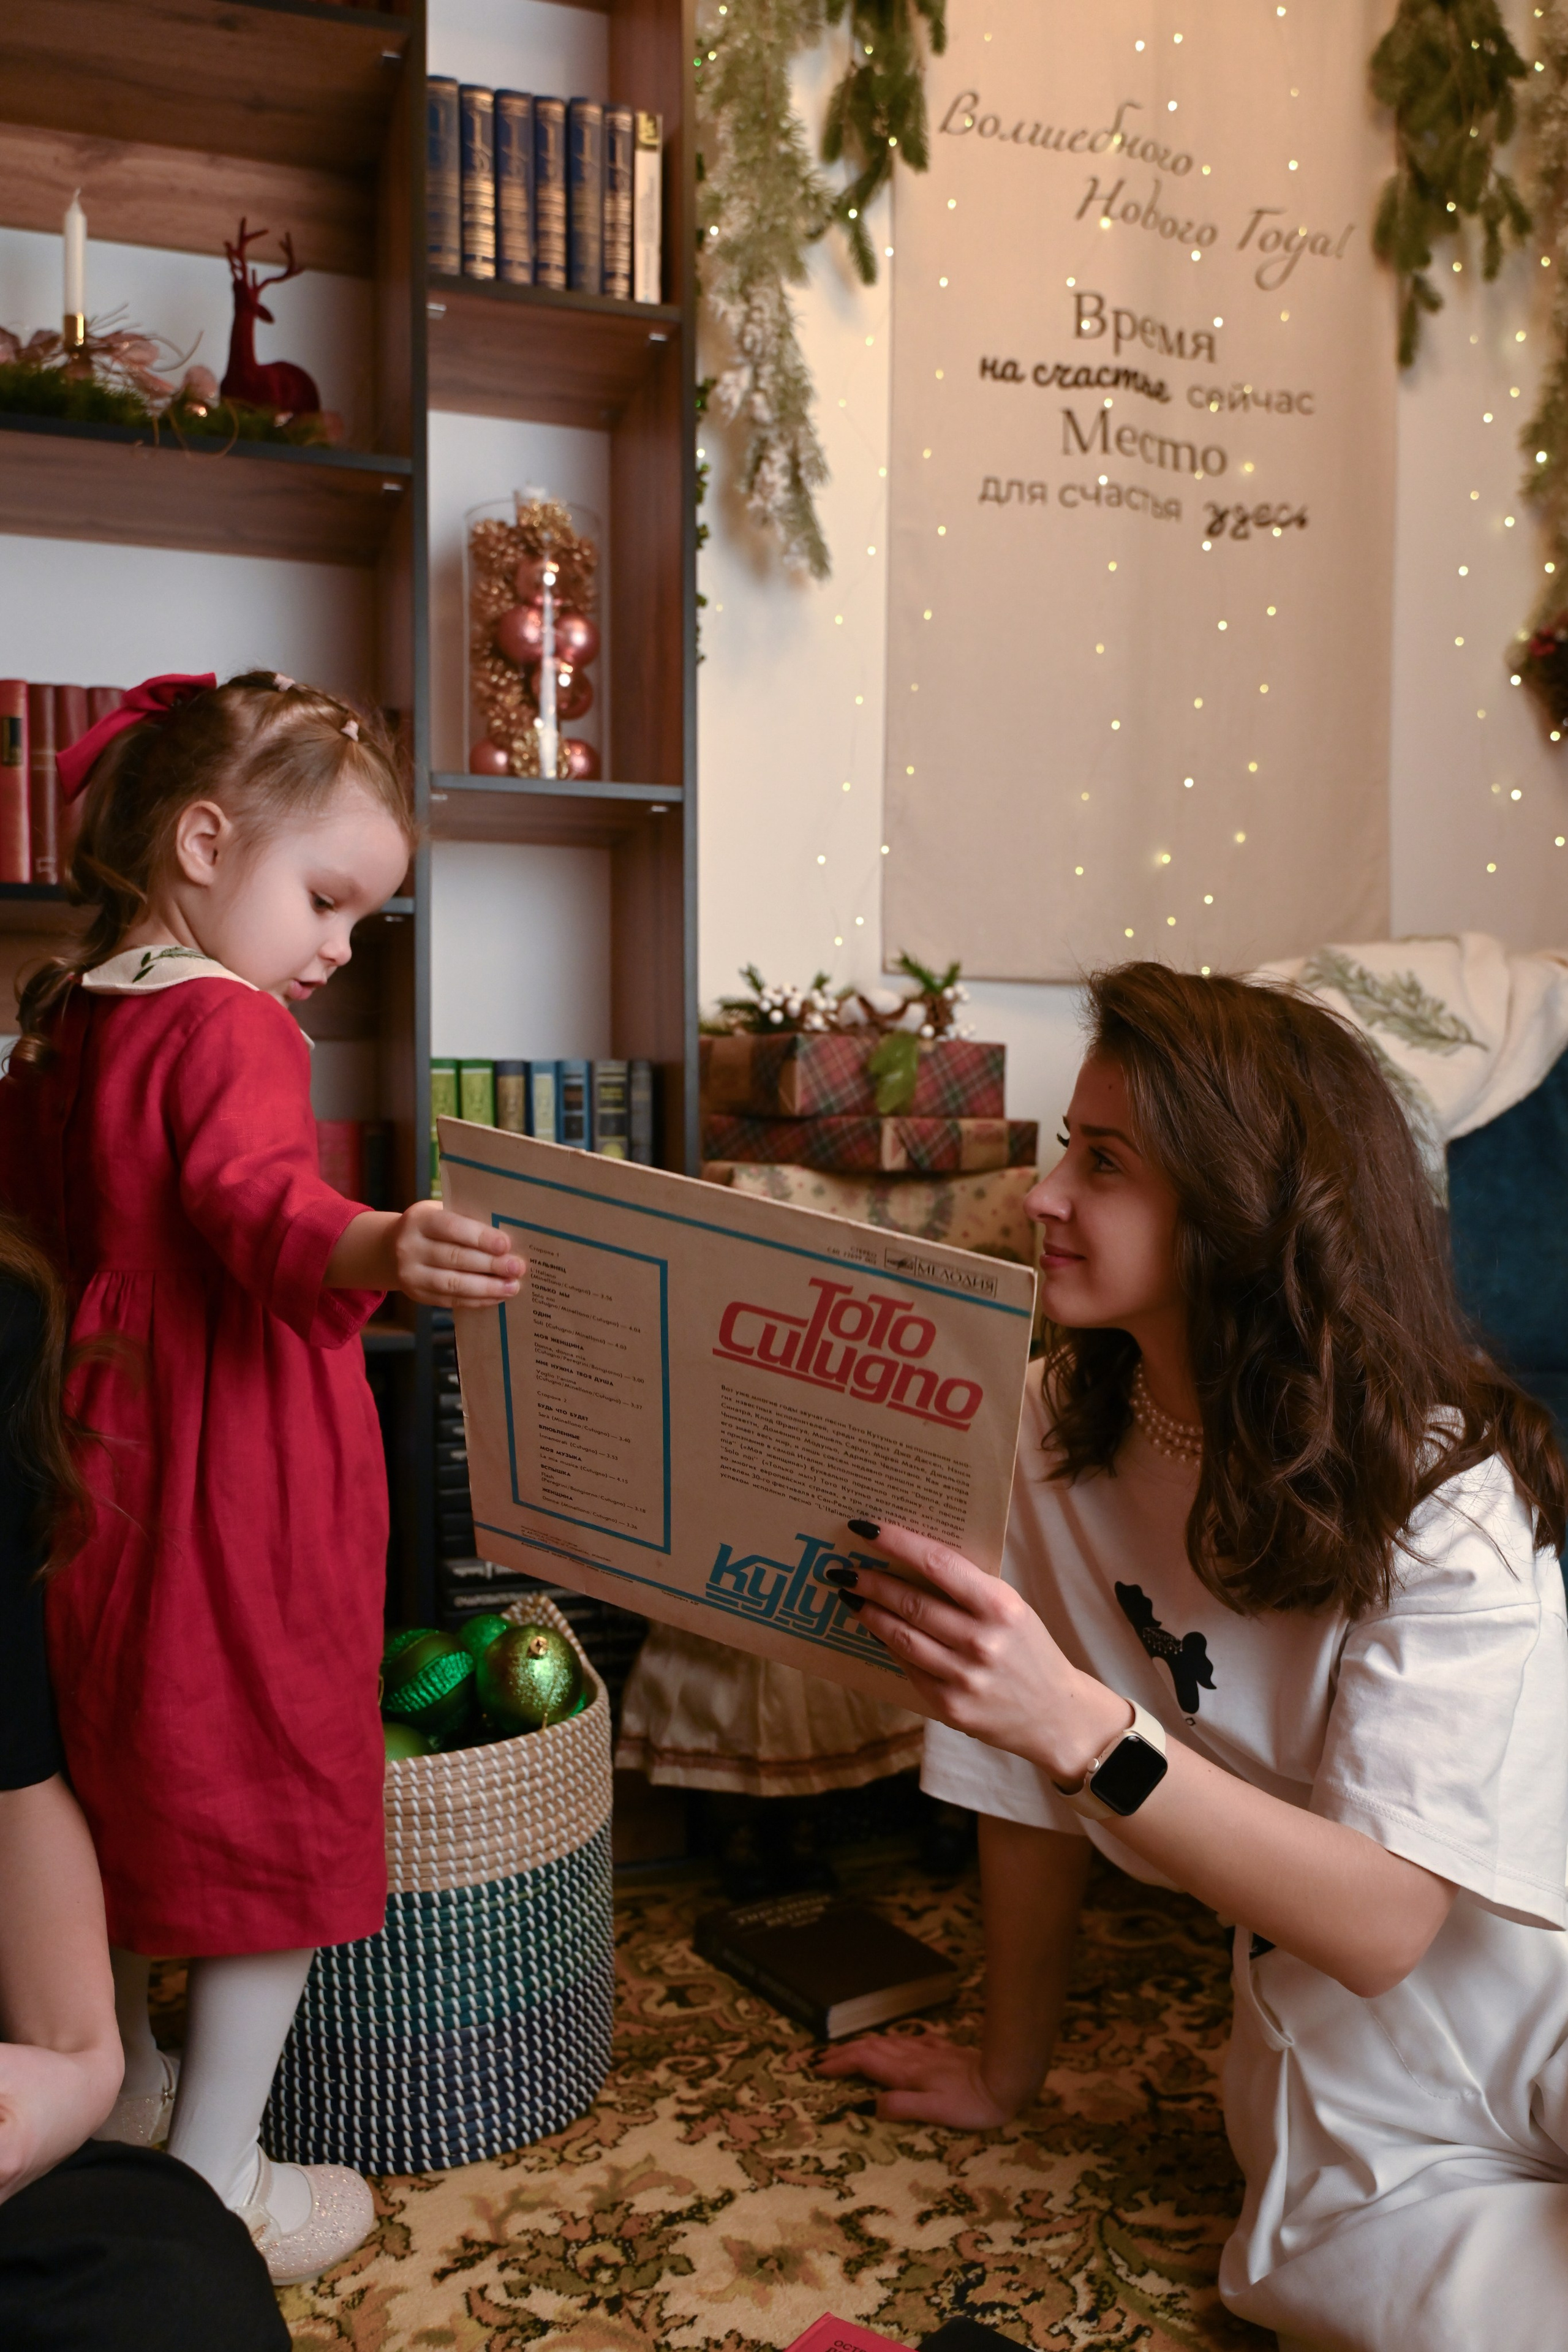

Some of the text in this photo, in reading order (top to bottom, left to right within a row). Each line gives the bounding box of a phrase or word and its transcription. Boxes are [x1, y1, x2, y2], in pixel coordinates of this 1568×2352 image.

[938, 91, 1195, 176] Волшебного
[1075, 176, 1355, 291] Нового Года!
[1073, 292, 1216, 363] Время
[980, 356, 1315, 415] на счастье сейчас
[1061, 407, 1229, 476] Место
[980, 476, 1048, 505] для
[1058, 481, 1182, 522] счастья
[529, 1257, 567, 1274] ИТАЛЬЯНЕЦ
[530, 1283, 556, 1294] ТОЛЬКО
[532, 1309, 551, 1319] ОДНИ
[550, 1336, 584, 1351] ЖЕНЩИНА
[550, 1363, 573, 1374] НУЖНА
[576, 1370, 592, 1379] ТВОЯ
[594, 1376, 614, 1387] ДУША
[537, 1402, 553, 1411] БУДЬ
[569, 1411, 588, 1422] БУДЕТ
[538, 1423, 580, 1440] ВЛЮБЛЕННЫЕ
[721, 1384, 733, 1393] Вот
[751, 1395, 777, 1407] многие
[779, 1404, 797, 1413] годы
[799, 1409, 823, 1420] звучат
[824, 1417, 846, 1428] песни
[848, 1423, 865, 1434] Тото
[867, 1429, 897, 1445] Кутуньо
[735, 1399, 772, 1414] известных
[832, 1429, 854, 1440] среди
[858, 1438, 889, 1452] которых
[893, 1448, 911, 1458] Джо
[755, 1412, 773, 1424] Клод
[812, 1431, 842, 1446] Мишель
[873, 1450, 899, 1464] Мирей
[539, 1444, 582, 1461] МОЯ МУЗЫКА
[540, 1463, 571, 1477] ВСПЫШКА
[726, 1431, 764, 1447] признание
[772, 1446, 795, 1457] самой
[827, 1462, 872, 1482] Исполнение
[887, 1483, 908, 1494] песни
[943, 1502, 967, 1514] donna
[735, 1425, 754, 1435] знает
[756, 1431, 772, 1441] весь
[801, 1446, 820, 1456] лишь
[823, 1453, 849, 1465] совсем
[851, 1463, 883, 1476] недавно
[884, 1474, 914, 1487] пришли
[923, 1487, 943, 1498] нему
[946, 1494, 967, 1505] успех
[762, 1424, 801, 1441] Доменико
[843, 1450, 876, 1465] Адриано
[925, 1476, 939, 1486] Как
[942, 1483, 968, 1496] автора
[541, 1487, 573, 1501] ЖЕНЩИНА
[720, 1472, 748, 1485] успехом
[752, 1483, 785, 1497] исполнил
[788, 1494, 812, 1506] песню
[720, 1463, 750, 1477] дителем
[752, 1472, 770, 1483] 30-го
[771, 1480, 809, 1496] фестиваля
[902, 1525, 919, 1534] году
[927, 1532, 962, 1550] большим
[731, 1459, 756, 1471] многих
[760, 1468, 805, 1487] европейских
[865, 1503, 882, 1513] года
[885, 1510, 907, 1521] назад
[922, 1523, 938, 1531] стал
[941, 1529, 962, 1540] побе-
[810, 1466, 848, 1483] буквально
[852, 1480, 887, 1496] поразило
[938, 1510, 965, 1523] песней
[821, 1477, 837, 1488] Тото
[841, 1484, 871, 1499] Кутуньо
[875, 1498, 916, 1515] возглавлял
